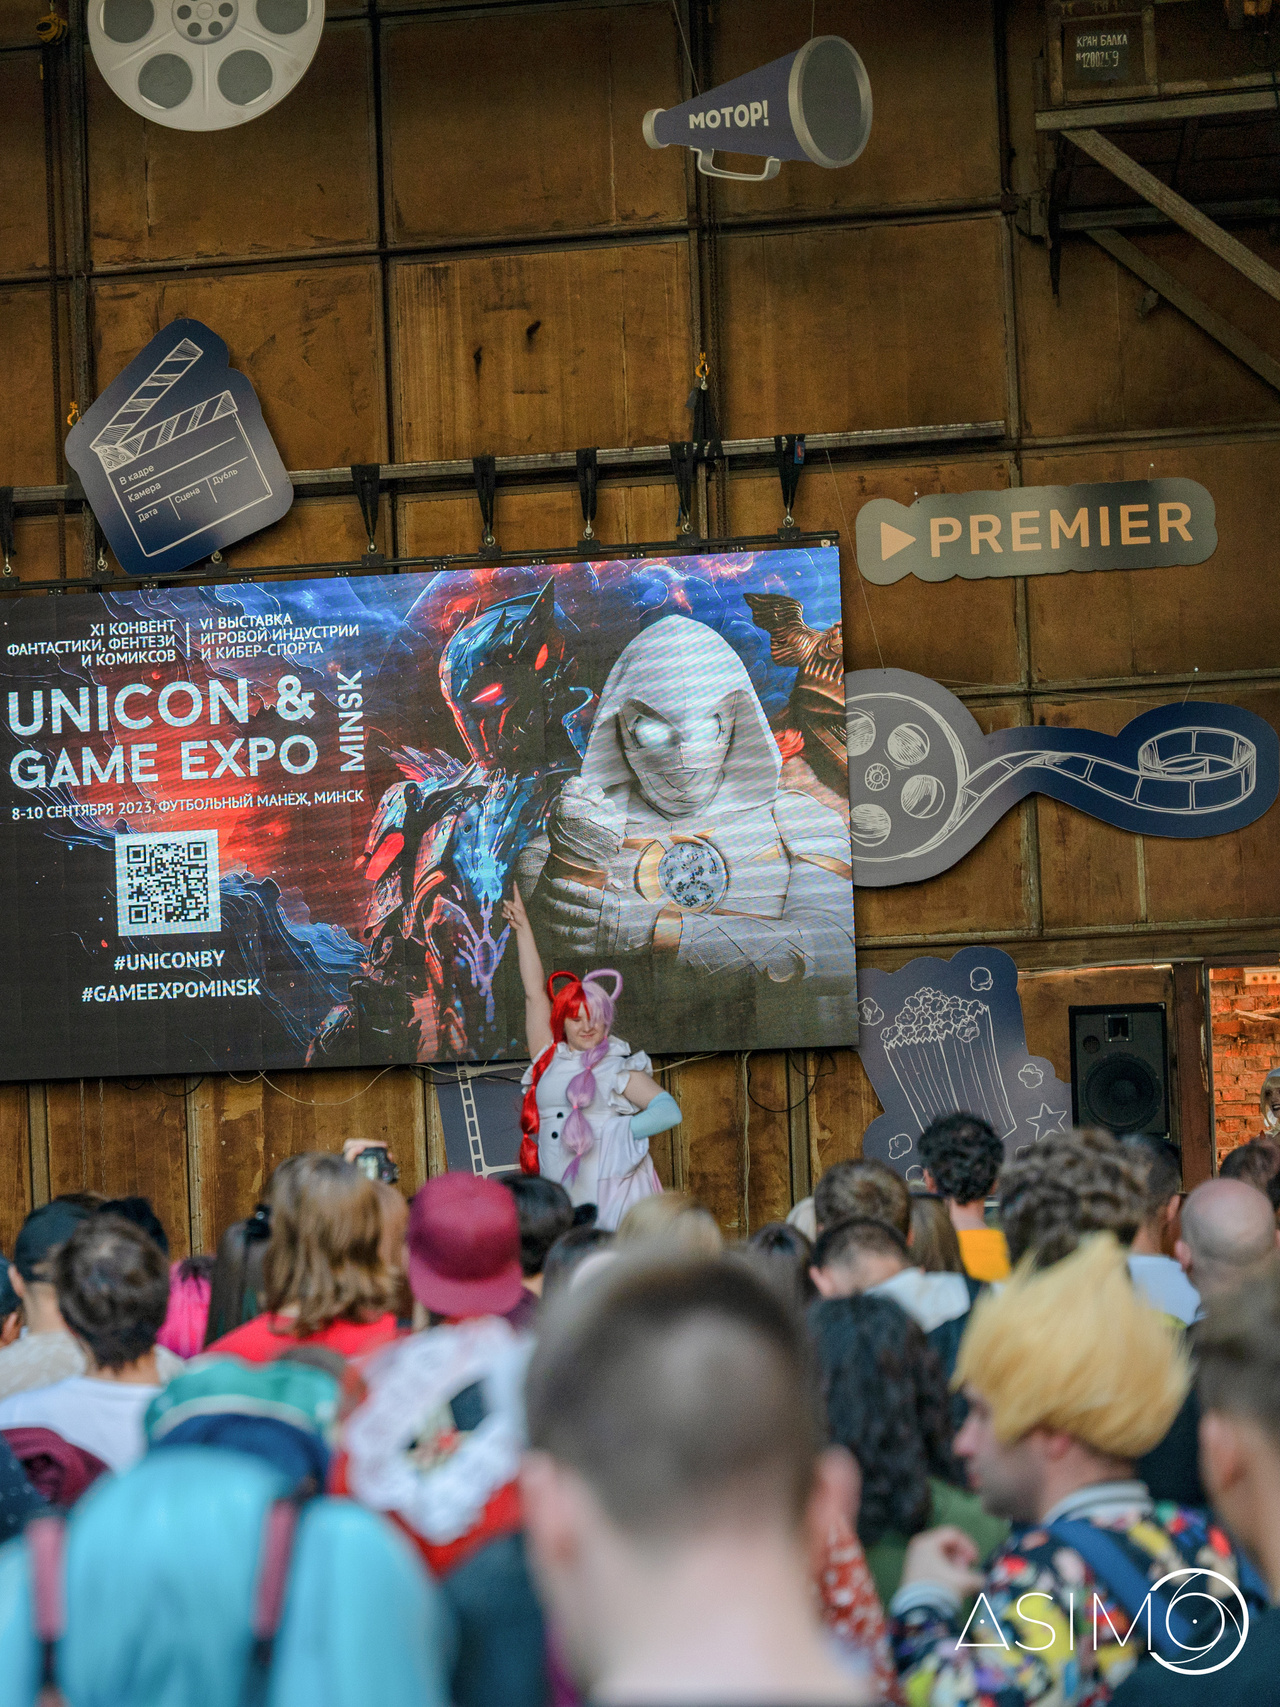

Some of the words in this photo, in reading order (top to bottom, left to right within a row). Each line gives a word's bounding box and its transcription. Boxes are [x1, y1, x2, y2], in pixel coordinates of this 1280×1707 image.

[1076, 35, 1098, 48] КРАН
[1100, 33, 1128, 46] БАЛКА
[688, 99, 770, 129] МОТОР!
[119, 476, 127, 486] В
[127, 464, 155, 482] кадре
[212, 468, 238, 486] Дубль
[127, 481, 162, 503] Камера
[174, 486, 201, 504] Сцена
[137, 507, 158, 523] Дата
[930, 501, 1194, 558] PREMIER
[109, 619, 177, 636] КОНВЕНТ
[218, 612, 293, 630] ВЫСТАВКА
[7, 639, 106, 657] ФАНТАСТИКИ,
[108, 634, 176, 651] ФЕНТЕЗИ
[200, 627, 268, 646] ИГРОВОЙ
[272, 624, 360, 641] ИНДУСТРИИ
[81, 654, 92, 667] И
[96, 649, 177, 667] КОМИКСОВ
[200, 647, 212, 660] И
[215, 640, 324, 660] КИБЕР-СПОРТА
[8, 677, 250, 736] UNICON
[276, 674, 316, 721] &
[336, 669, 365, 773] MINSK
[9, 742, 159, 790] GAME
[180, 734, 319, 781] EXPO
[11, 806, 43, 820] 8-10
[46, 802, 114, 819] СЕНТЯБРЯ
[118, 800, 156, 815] 2023,
[158, 793, 253, 813] ФУТБОЛЬНЫЙ
[256, 791, 312, 807] МАНЕЖ,
[314, 789, 365, 804] МИНСК
[114, 949, 226, 971] #UNICONBY
[81, 978, 262, 1003] #GAMEEXPOMINSK
